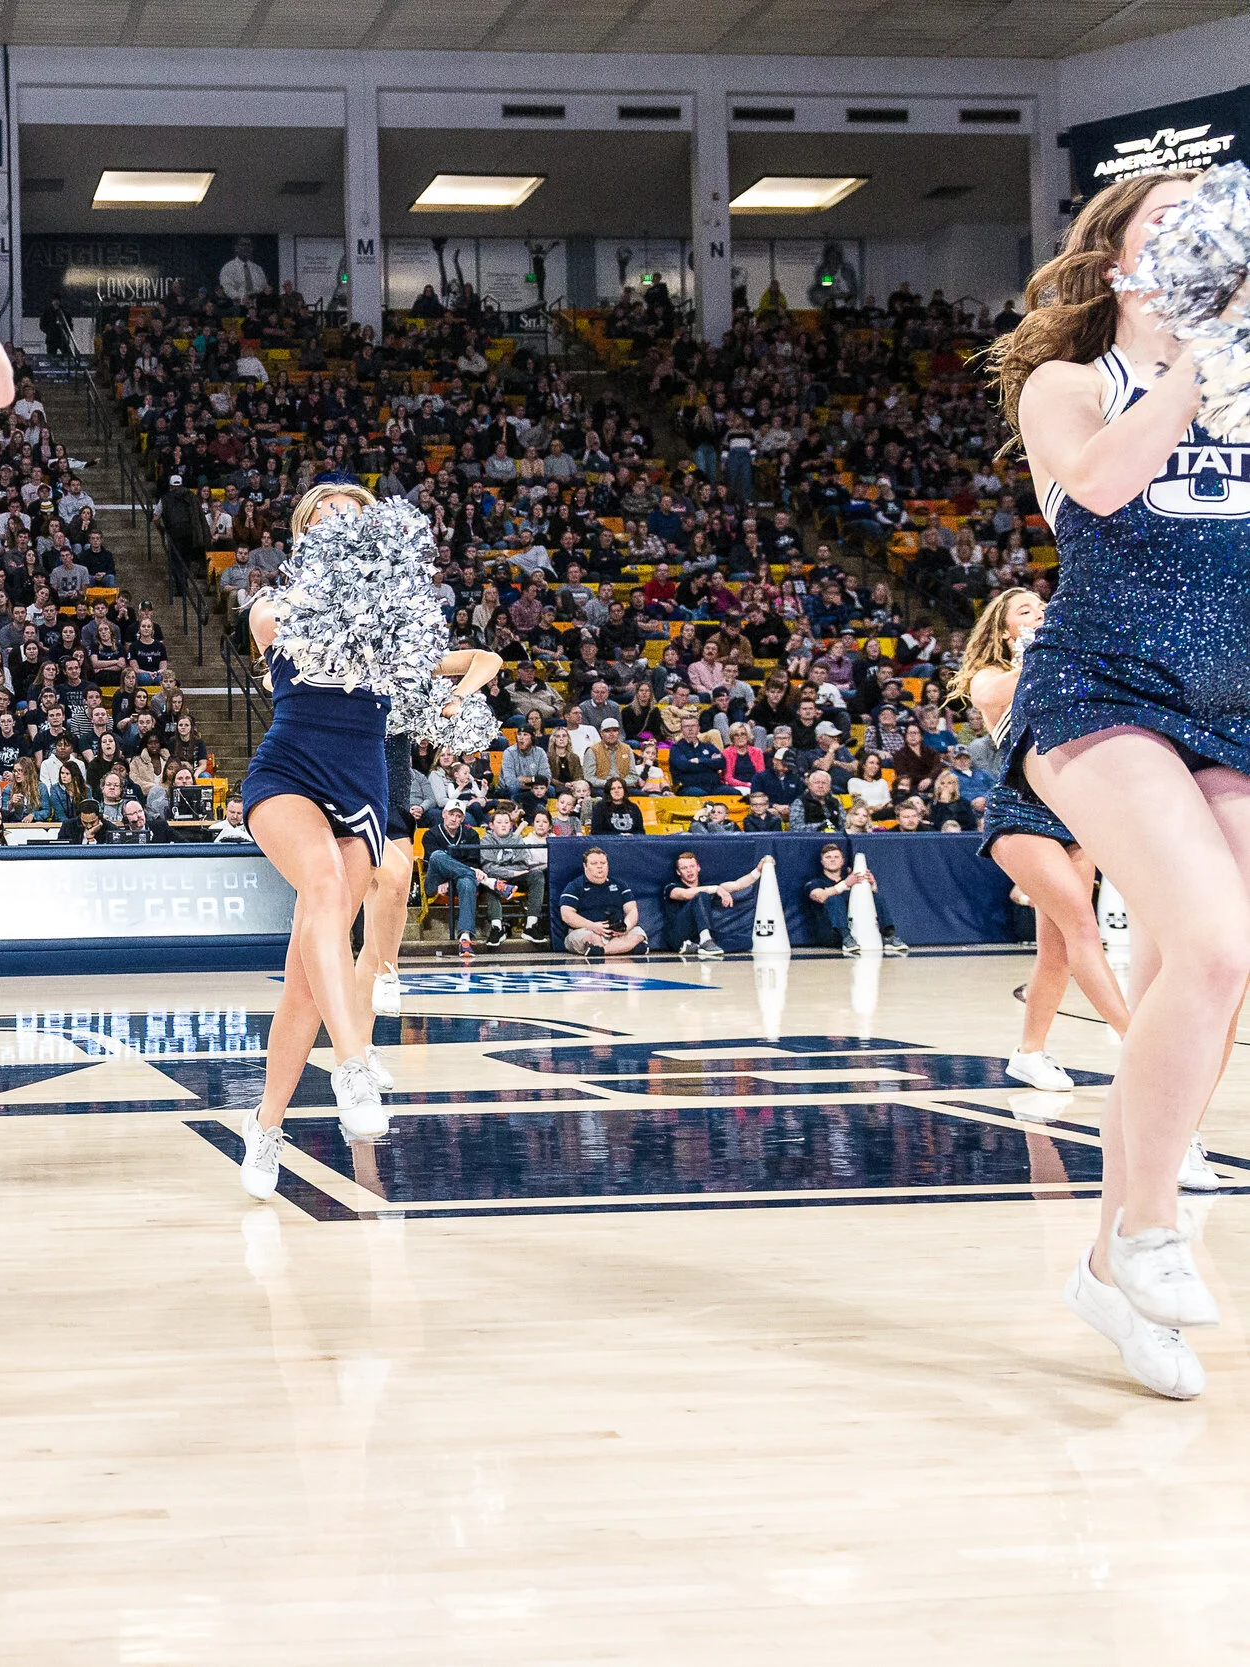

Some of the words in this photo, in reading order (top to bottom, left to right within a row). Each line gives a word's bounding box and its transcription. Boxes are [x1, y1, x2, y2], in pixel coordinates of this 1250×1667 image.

[1093, 147, 1177, 178] AMERICA
[1177, 134, 1236, 160] FIRST
[357, 238, 374, 256] M
[710, 241, 725, 258] N
[84, 872, 195, 892] SOURCE
[206, 872, 259, 890] FOR
[143, 896, 246, 923] GEAR
